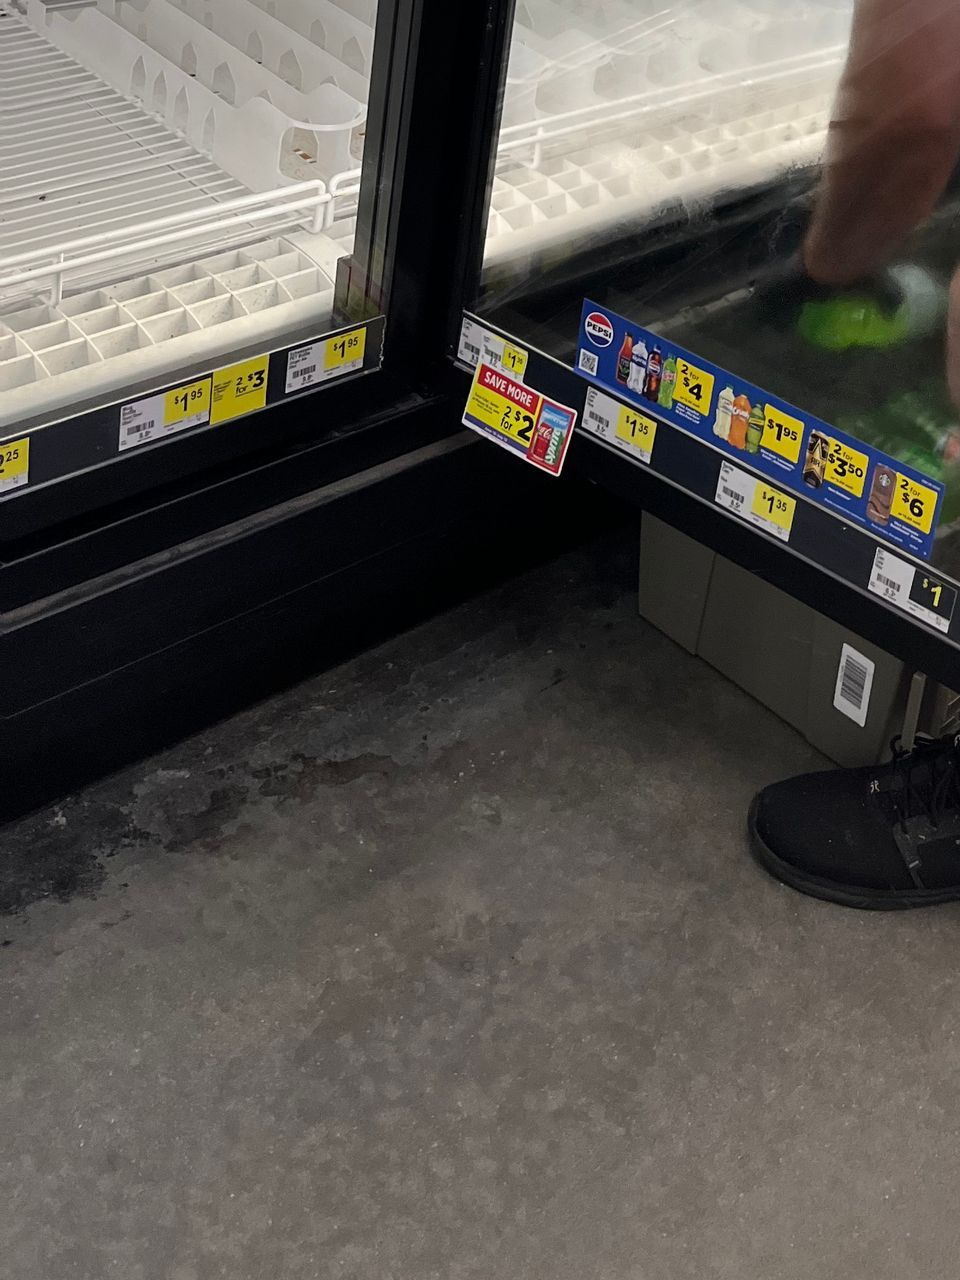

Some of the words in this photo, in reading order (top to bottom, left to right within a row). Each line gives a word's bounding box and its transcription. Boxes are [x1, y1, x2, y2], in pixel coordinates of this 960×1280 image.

[585, 320, 612, 340] PEPSI
[236, 376, 243, 387] 2
[247, 370, 265, 388] $3
[681, 364, 689, 375] 2
[689, 370, 700, 381] for
[235, 385, 248, 396] for
[484, 371, 507, 394] SAVE
[507, 381, 534, 407] MORE
[683, 377, 703, 401] $4
[500, 417, 513, 431] for
[505, 406, 512, 418] 2
[513, 411, 534, 442] $2
[833, 443, 843, 455] 2
[843, 450, 854, 462] for
[900, 479, 909, 491] 2
[909, 485, 922, 497] for
[902, 491, 924, 518] $6
[922, 577, 942, 607] $1
